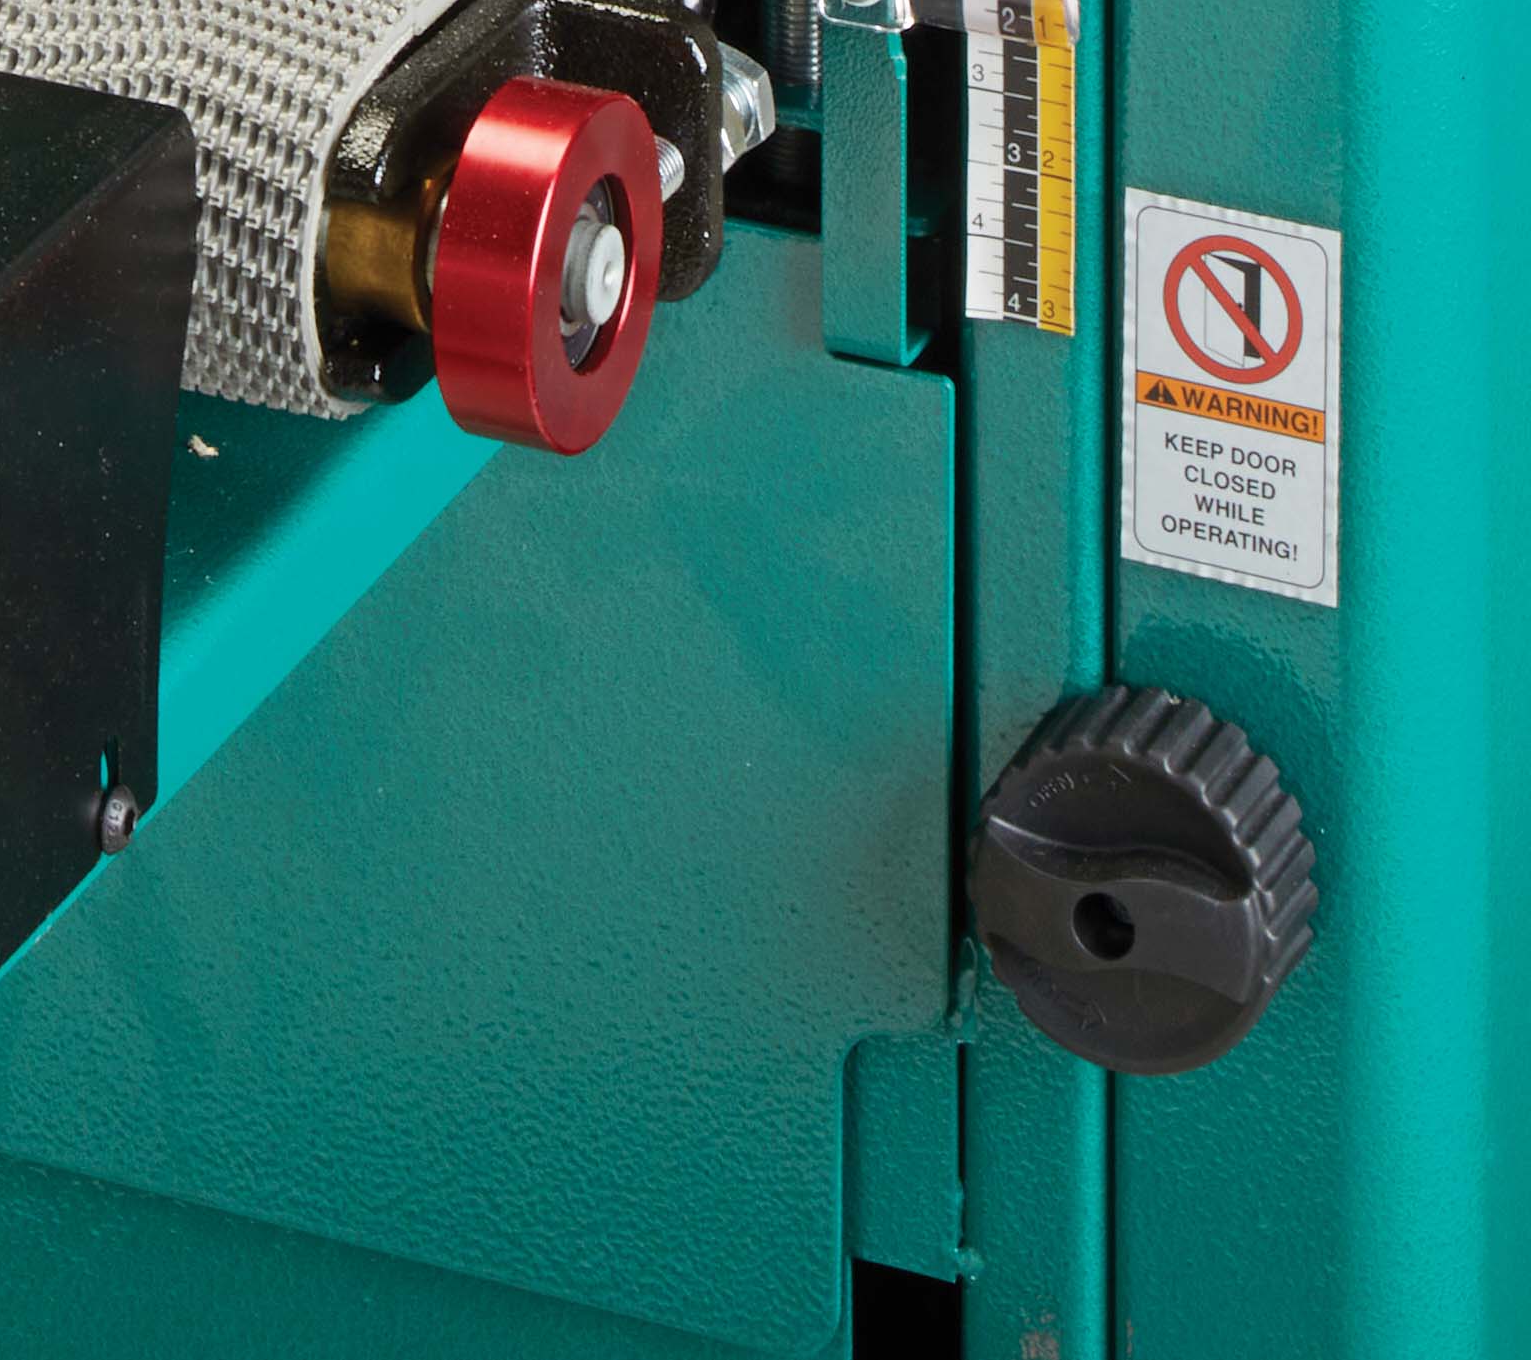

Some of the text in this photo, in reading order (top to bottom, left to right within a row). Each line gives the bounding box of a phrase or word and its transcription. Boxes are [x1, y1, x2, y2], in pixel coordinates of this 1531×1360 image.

[1001, 6, 1016, 32] 2
[971, 64, 984, 82] 3
[1007, 143, 1021, 162] 3
[1043, 151, 1055, 168] 2
[972, 212, 984, 230] 4
[1008, 292, 1021, 311] 4
[1043, 300, 1055, 319] 3
[1181, 386, 1318, 437] WARNING!
[1165, 431, 1296, 478] KEEP DOOR
[1184, 464, 1276, 500] CLOSED
[1194, 493, 1265, 527] WHILE
[1161, 514, 1298, 562] OPERATING!
